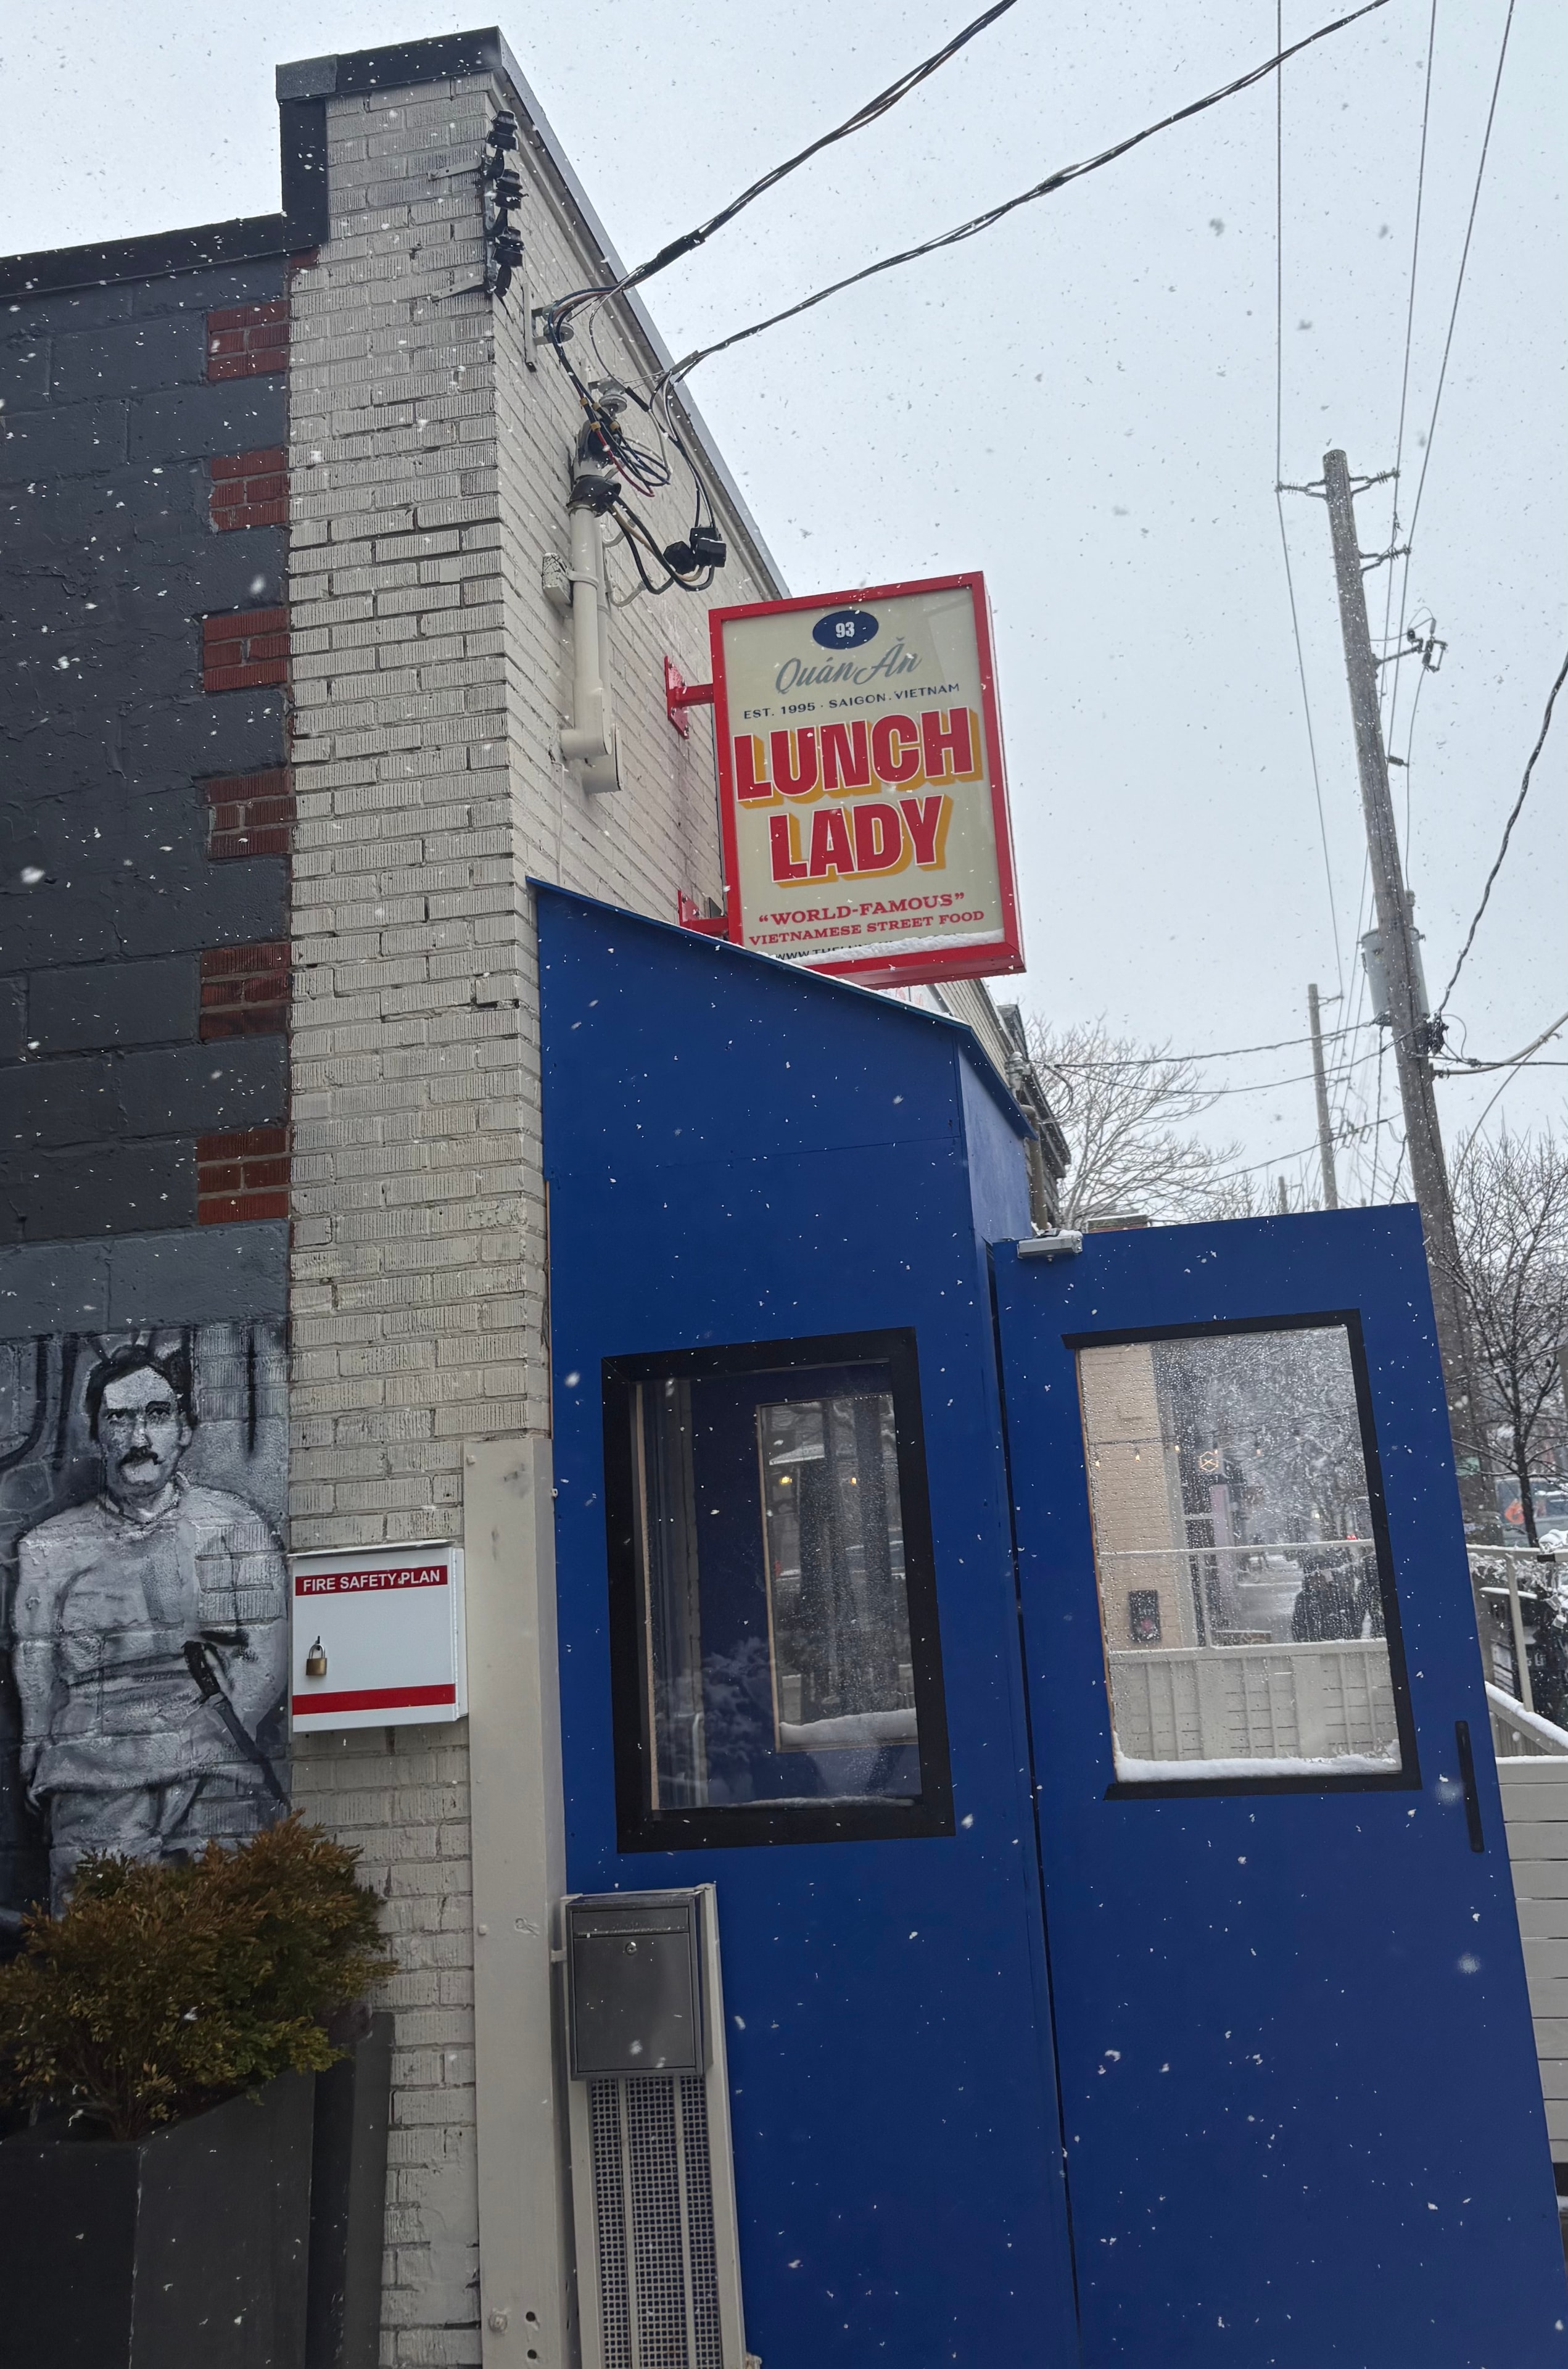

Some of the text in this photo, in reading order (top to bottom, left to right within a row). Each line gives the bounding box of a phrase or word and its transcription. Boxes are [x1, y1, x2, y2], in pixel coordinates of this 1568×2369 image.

[836, 621, 855, 638] 93
[775, 636, 923, 695] Quán Ăn
[744, 708, 775, 719] EST.
[781, 702, 815, 714] 1995
[894, 683, 960, 700] VIETNAM
[733, 706, 980, 805] LUNCH
[768, 794, 950, 885] LADY
[749, 910, 985, 946] VIETNAMESE STREET FOOD
[303, 1569, 440, 1592] FIRE SAFETY PLAN
